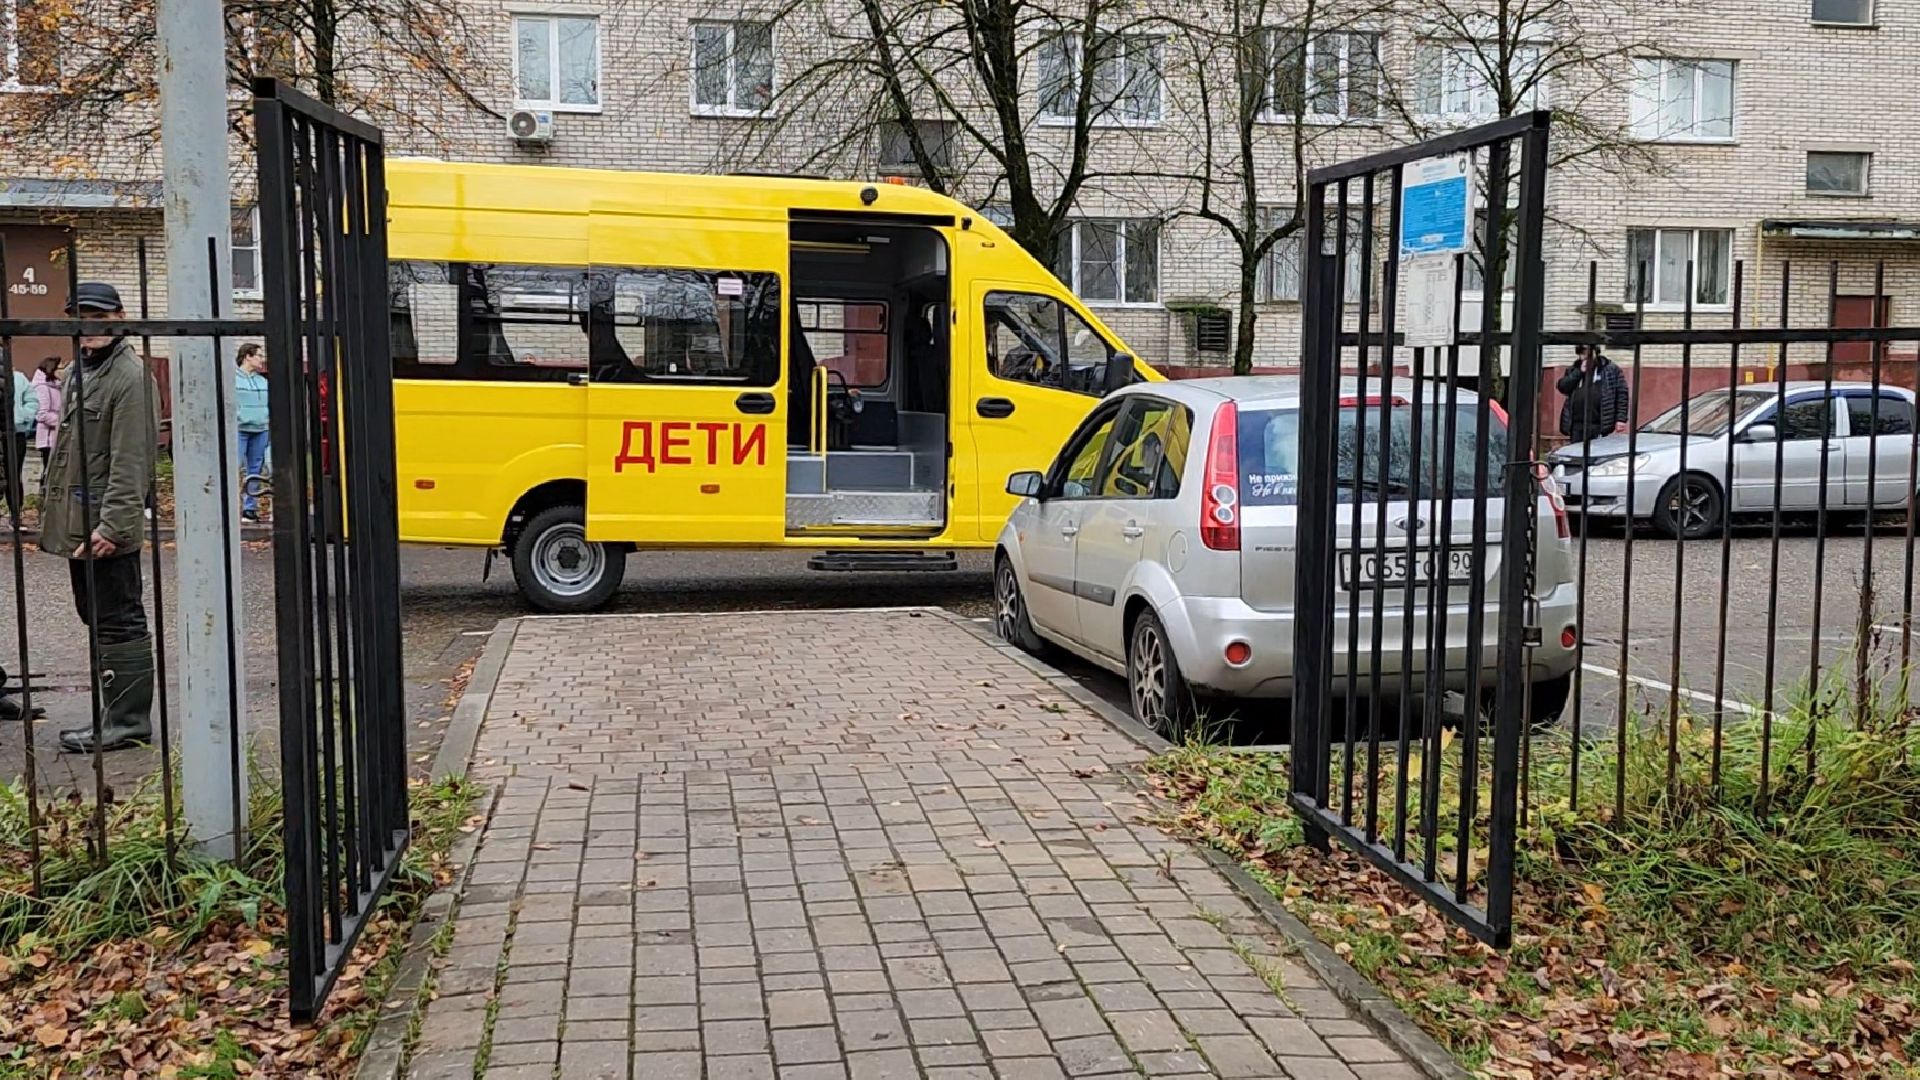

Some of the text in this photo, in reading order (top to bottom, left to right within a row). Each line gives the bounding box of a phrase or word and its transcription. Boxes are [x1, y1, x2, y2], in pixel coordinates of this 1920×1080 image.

[22, 267, 35, 283] 4
[8, 284, 48, 295] 45-59
[614, 421, 766, 474] ДЕТИ
[1248, 474, 1263, 484] Не
